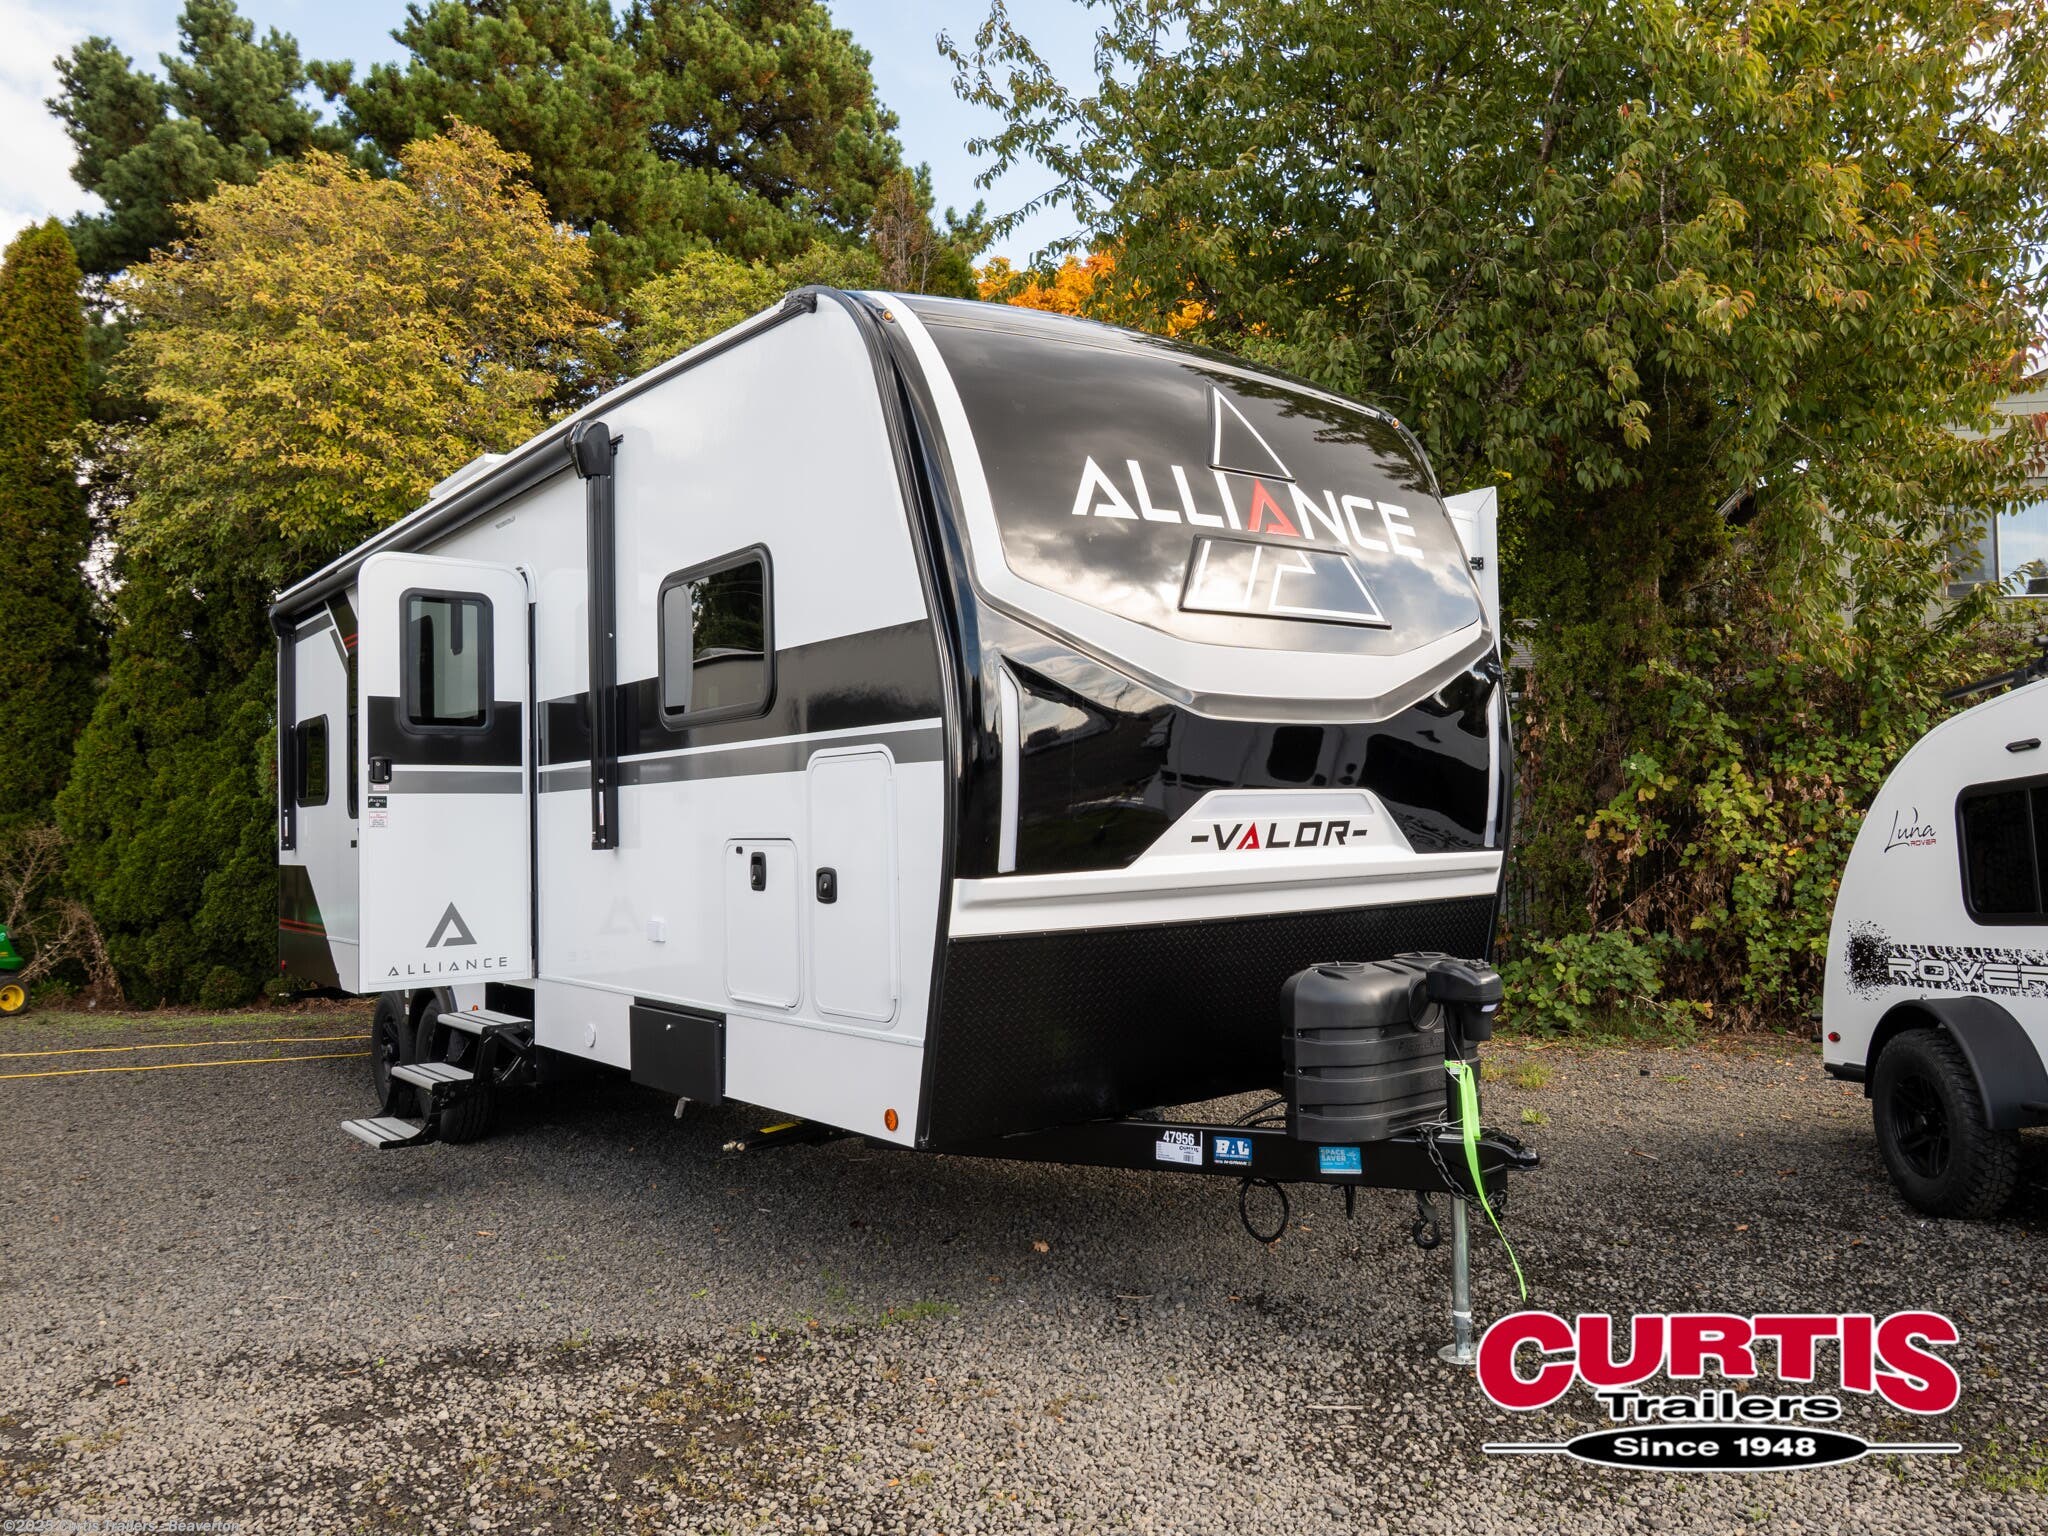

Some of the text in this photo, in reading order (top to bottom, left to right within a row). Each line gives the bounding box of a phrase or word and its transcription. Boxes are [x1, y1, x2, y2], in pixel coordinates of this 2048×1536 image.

[1072, 455, 1424, 560] ALLIANCE
[1885, 807, 1937, 853] Luna
[1910, 838, 1937, 848] ROVER
[387, 956, 508, 977] ALLIANCE
[1163, 1130, 1195, 1146] 47956
